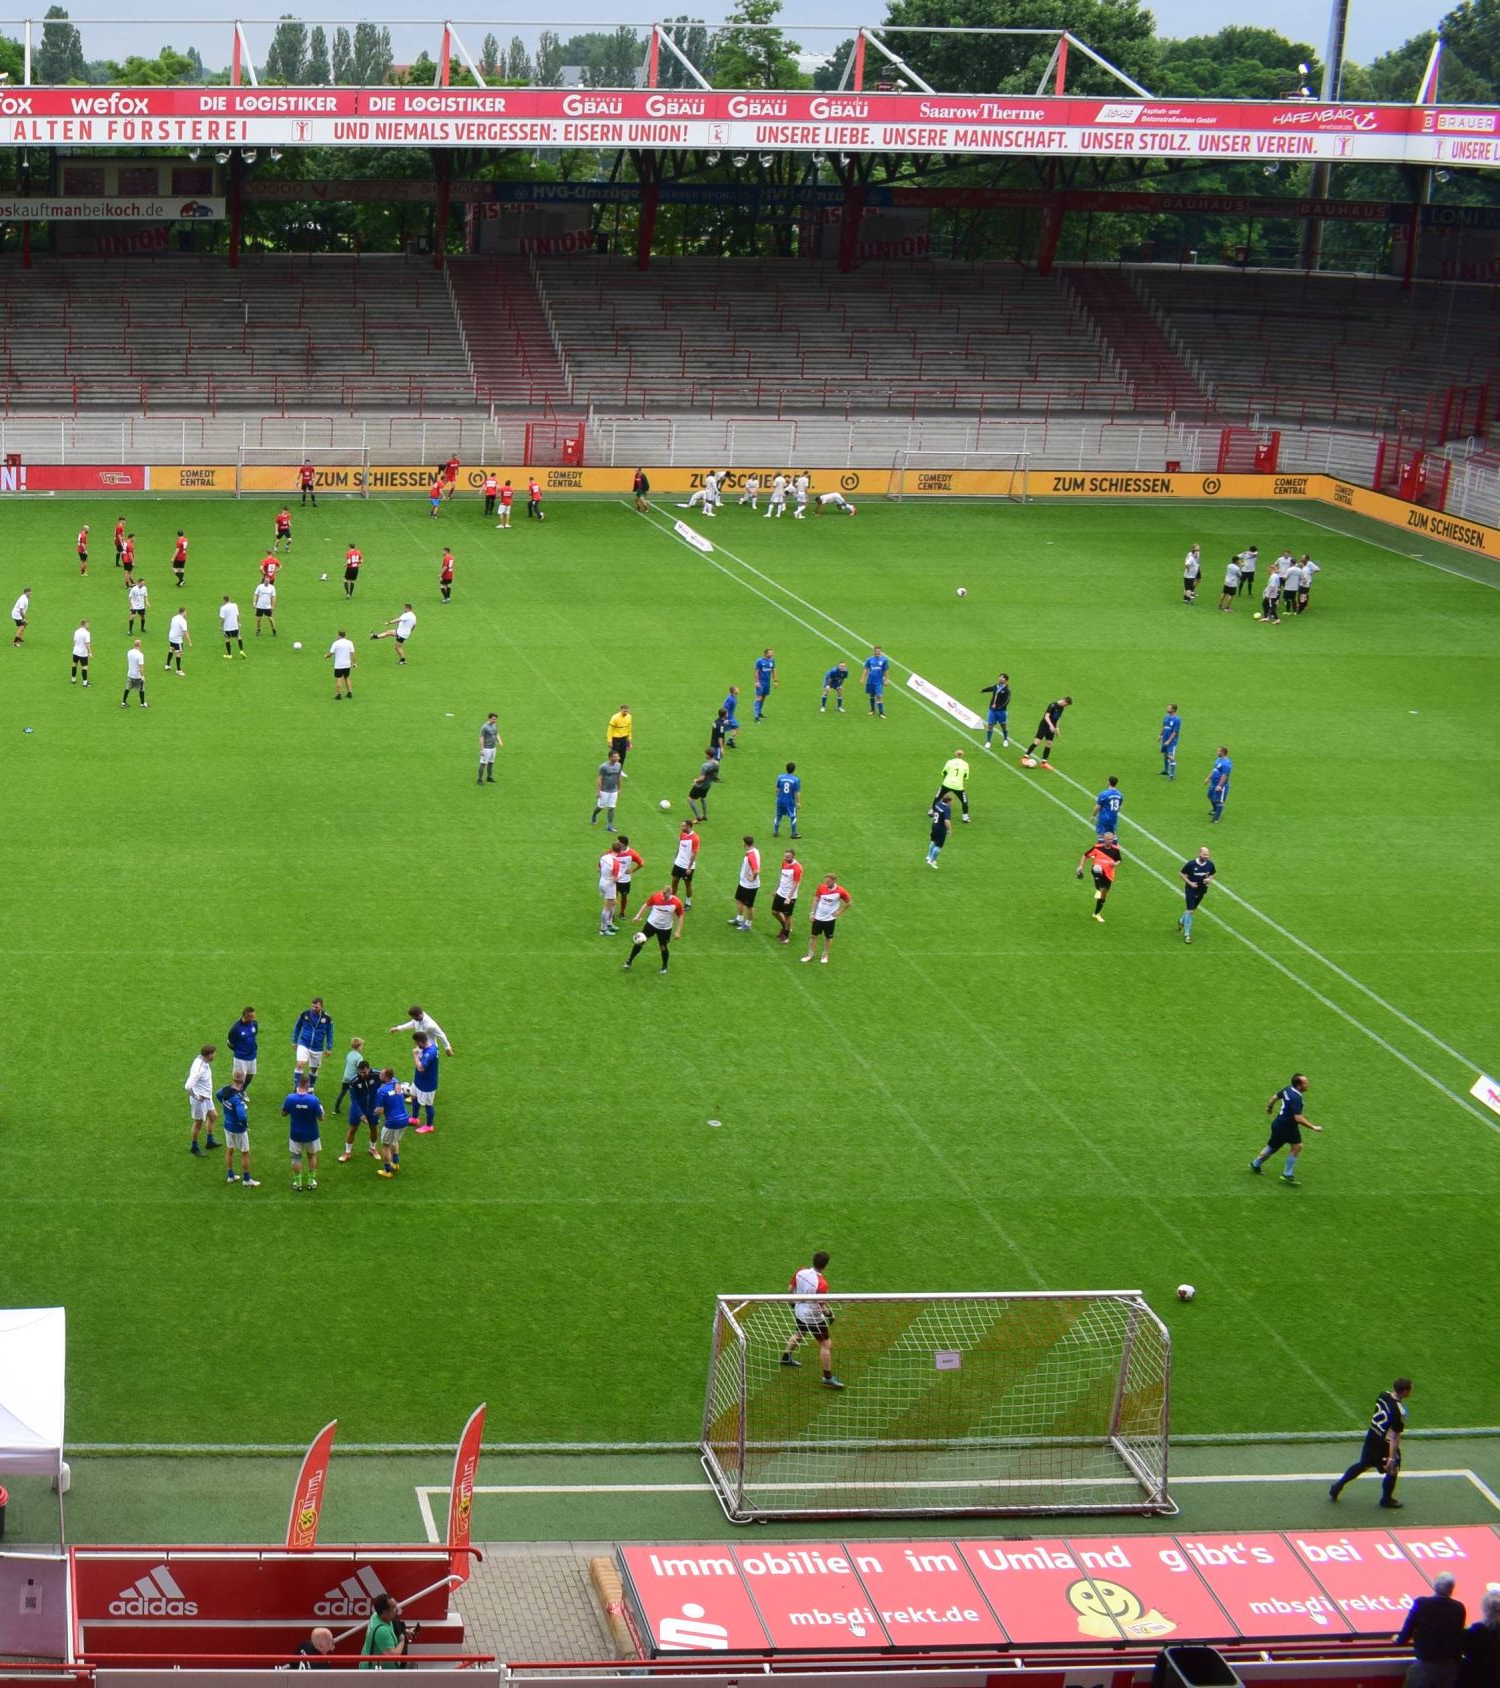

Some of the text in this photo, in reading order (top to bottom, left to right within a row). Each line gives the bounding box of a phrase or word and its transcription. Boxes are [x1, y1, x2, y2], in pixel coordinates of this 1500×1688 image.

[71, 92, 149, 114] wefox
[200, 97, 337, 111] DIE LOGISTIKER
[369, 97, 506, 112] DIE LOGISTIKER
[1272, 109, 1355, 124] HAFENBAR
[1439, 117, 1494, 129] BRAUER
[13, 121, 93, 140] ALTEN
[107, 119, 248, 141] FÖRSTEREI
[333, 122, 689, 143] UND NIEMALS VERGESSEN: EISERN UNION!
[755, 125, 1318, 155] UNSERE LIEBE. UNSERE MANNSCHAFT. UNSER STOLZ. UNSER VEREIN.
[1451, 141, 1492, 161] UNSERE
[1162, 199, 1246, 212] BAUHAUS
[1300, 203, 1388, 218] BAUHAUS
[180, 470, 216, 478] COMEDY
[315, 472, 348, 487] ZUM
[547, 471, 583, 480] COMEDY
[917, 473, 953, 482] COMEDY
[180, 478, 216, 487] CENTRAL
[547, 480, 583, 488] CENTRAL
[917, 482, 953, 491] CENTRAL
[1053, 477, 1174, 493] ZUM SCHIESSEN.
[1274, 478, 1308, 487] COMEDY
[1273, 486, 1307, 495] CENTRAL
[1407, 510, 1486, 549] ZUM SCHIESSEN.
[783, 782, 790, 793] 8
[1109, 799, 1120, 811] 13
[650, 1549, 884, 1578] Immobilien
[904, 1549, 958, 1574] im
[978, 1545, 1132, 1574] Umland
[1298, 1539, 1363, 1564] bei
[1375, 1536, 1467, 1560] uns!
[108, 1598, 199, 1617] adidas
[789, 1606, 980, 1627] mbsdirekt.de
